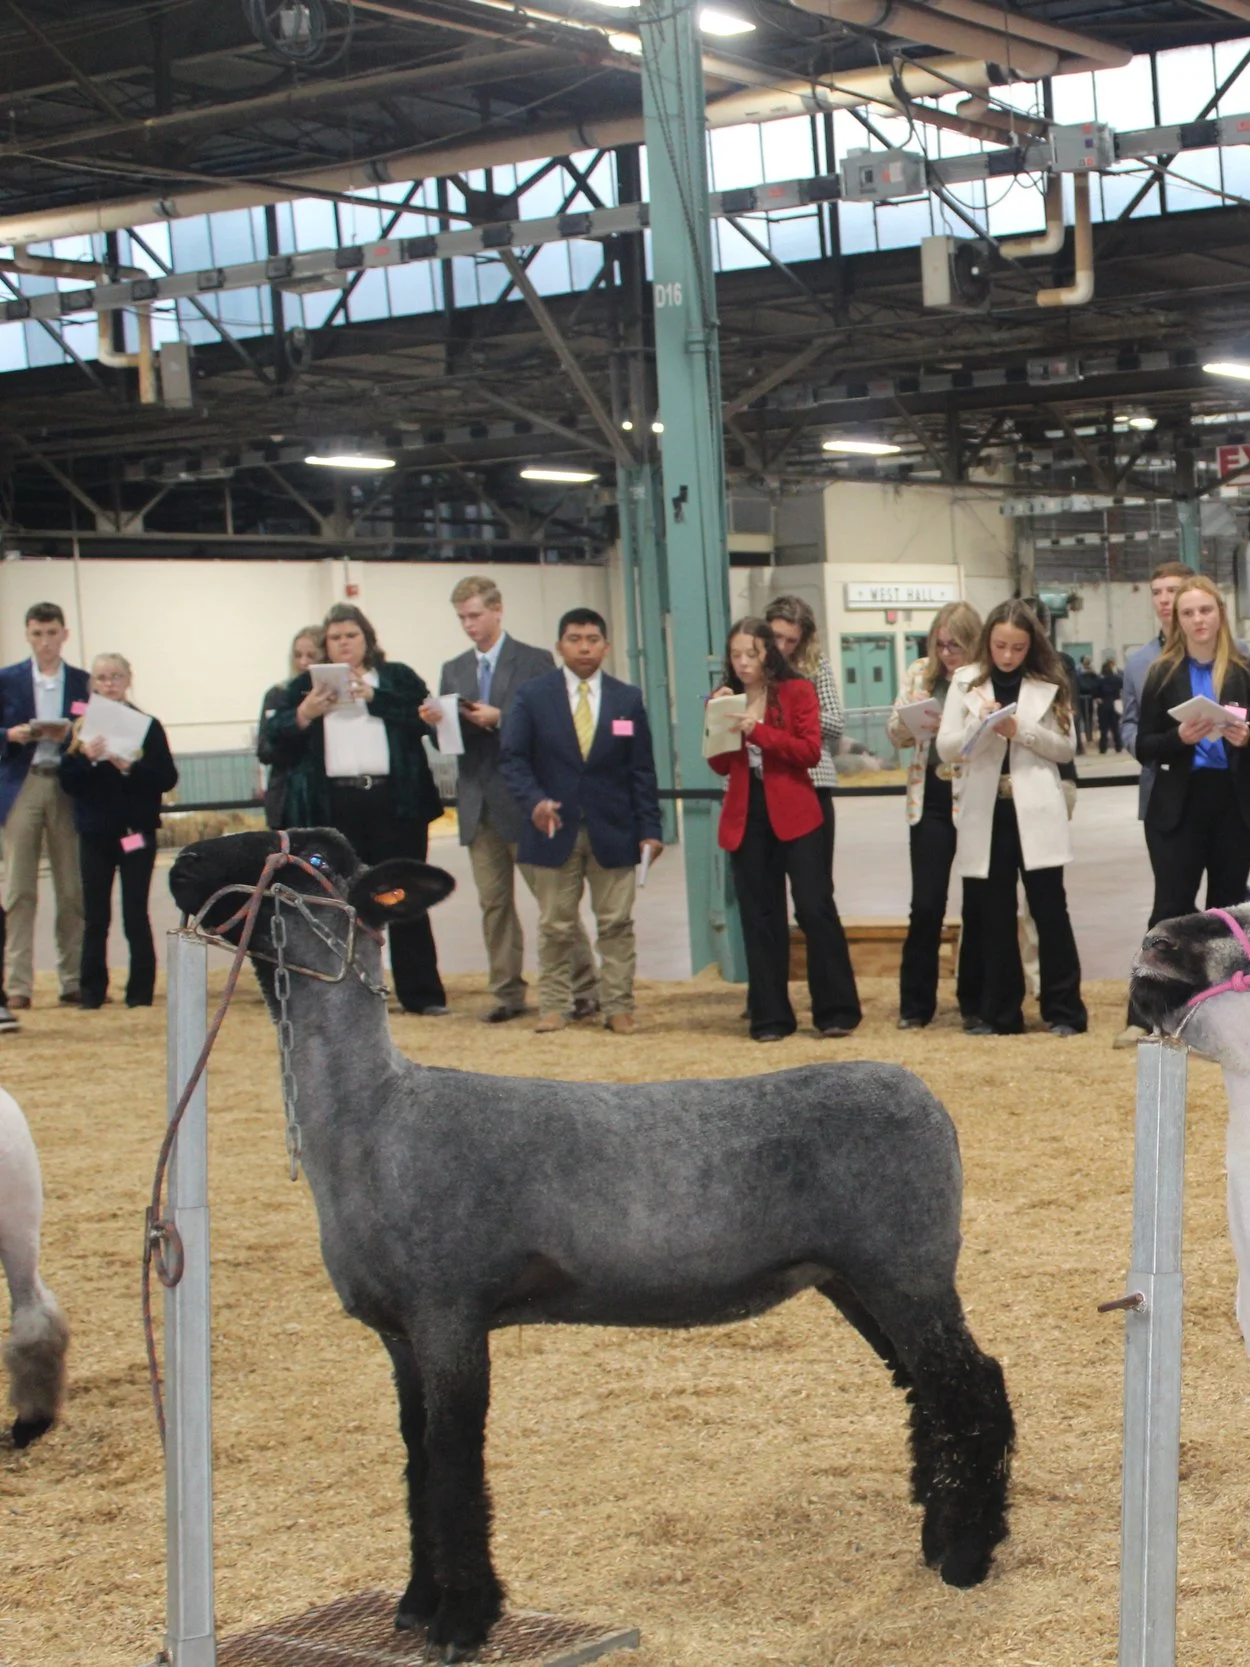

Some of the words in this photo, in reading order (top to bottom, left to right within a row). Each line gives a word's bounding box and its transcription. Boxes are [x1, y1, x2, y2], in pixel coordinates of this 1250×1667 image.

[655, 282, 682, 308] D16
[870, 587, 900, 602] WEST
[906, 587, 935, 602] HALL
